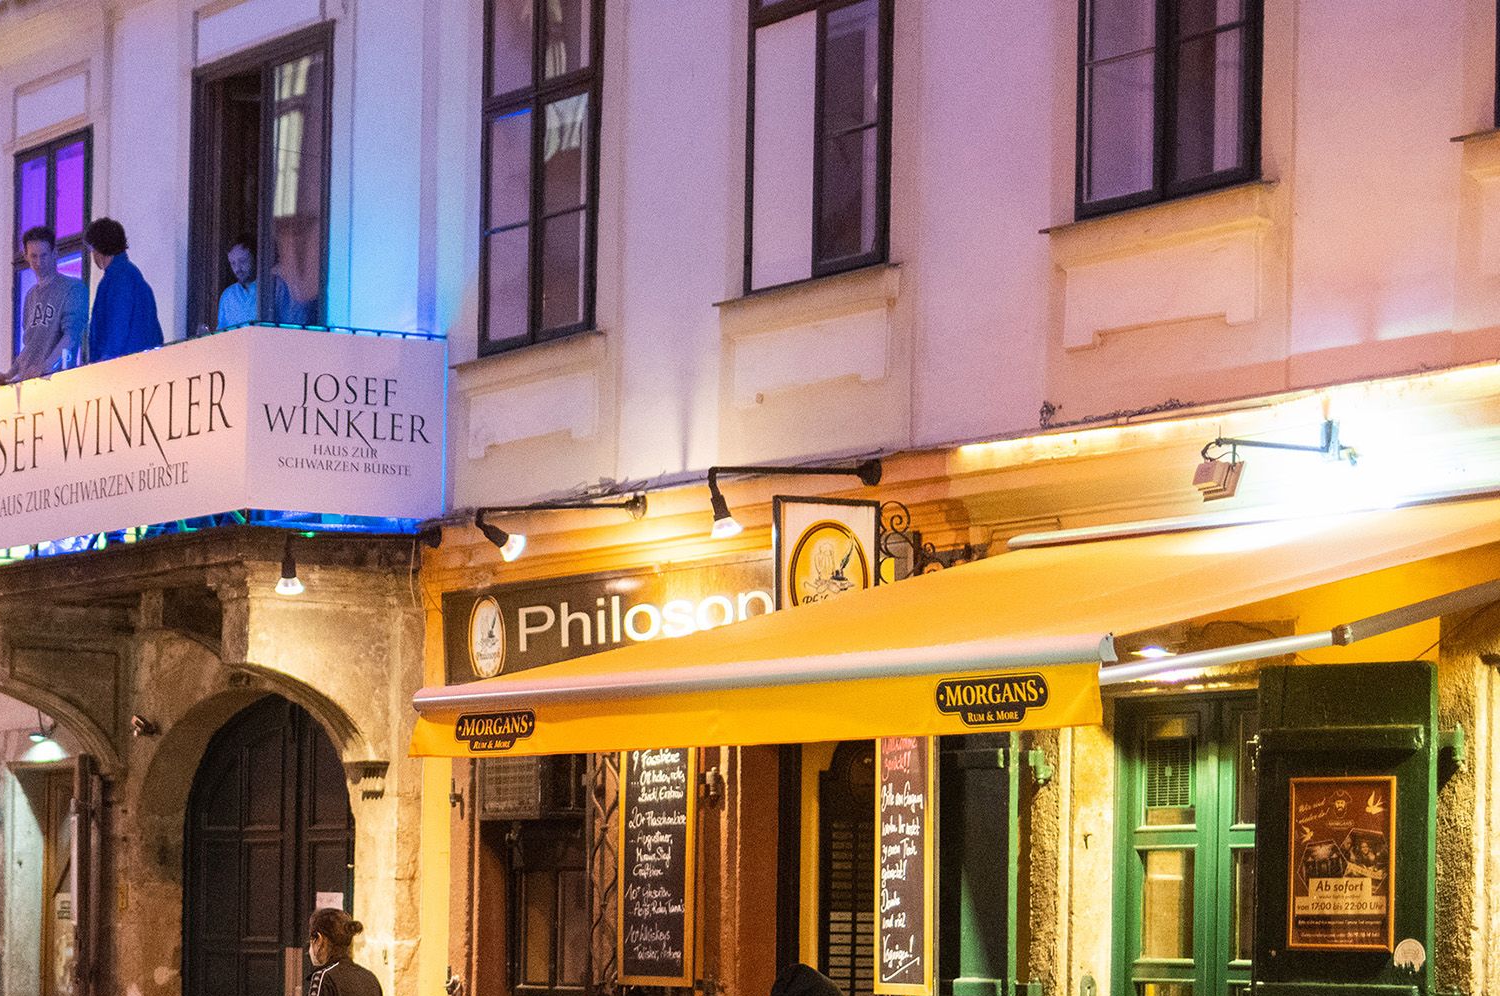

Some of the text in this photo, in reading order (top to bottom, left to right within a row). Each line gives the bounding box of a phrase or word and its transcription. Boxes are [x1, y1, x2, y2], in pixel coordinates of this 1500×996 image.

[302, 372, 398, 407] JOSEF
[58, 370, 233, 466] WINKLER
[263, 403, 431, 447] WINKLER
[313, 444, 378, 459] HAUS ZUR
[278, 457, 360, 474] SCHWARZEN
[26, 489, 50, 512] ZUR
[53, 477, 135, 508] SCHWARZEN
[138, 460, 189, 492] BÜRSTE
[946, 678, 1038, 707] MORGANS
[461, 714, 529, 738] MORGANS
[987, 709, 994, 722] &
[1316, 880, 1364, 894] Ab sofort
[1311, 902, 1332, 911] 17:00
[1344, 902, 1368, 911] 22:00
[1369, 902, 1384, 910] Uhr
